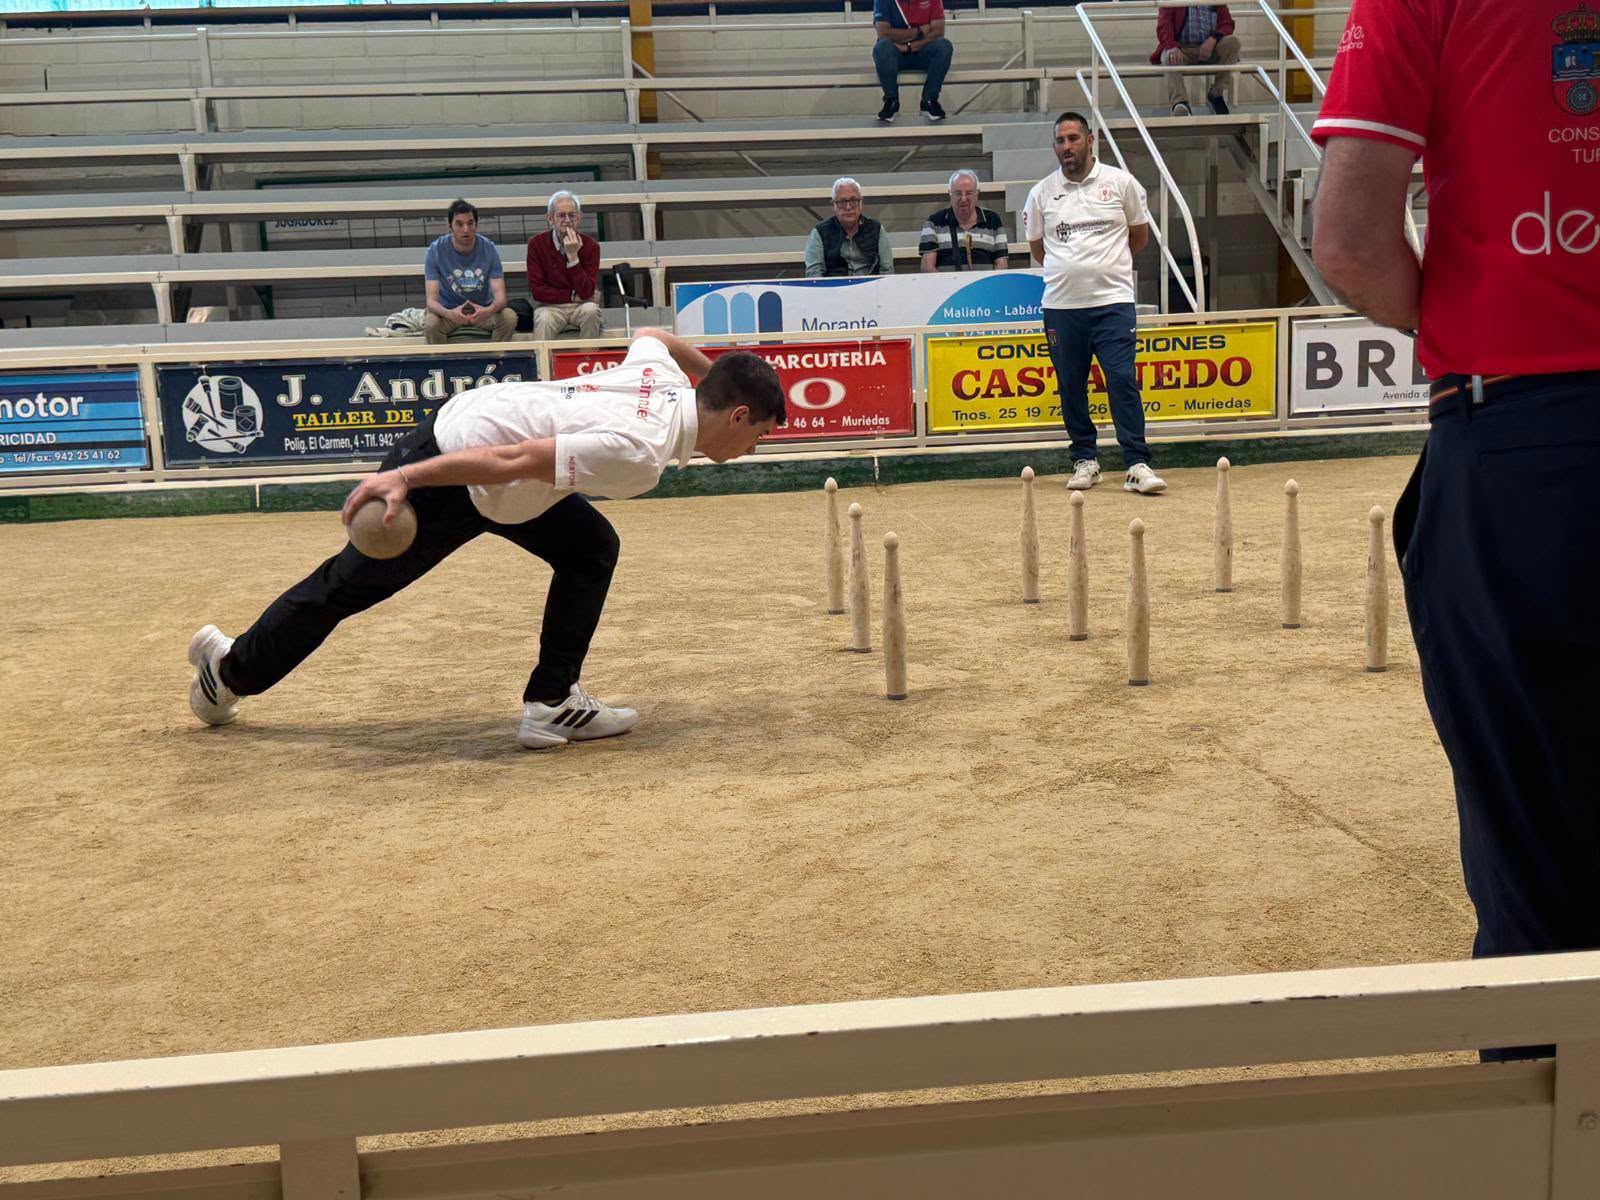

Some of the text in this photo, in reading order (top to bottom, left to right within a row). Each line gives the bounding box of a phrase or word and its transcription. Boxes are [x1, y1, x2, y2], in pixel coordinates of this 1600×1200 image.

[1548, 126, 1600, 143] CONS
[943, 306, 991, 318] Maliaño
[801, 316, 878, 331] Morante
[758, 351, 887, 370] HARCUTERIA
[276, 374, 323, 406] J.
[1382, 390, 1421, 400] Avenida
[952, 410, 991, 420] Tnos.
[999, 408, 1018, 419] 25
[1026, 406, 1041, 418] 19
[1089, 404, 1108, 415] 26
[1142, 401, 1161, 413] 70
[1184, 397, 1252, 411] Muriedas
[293, 410, 376, 427] TALLER
[385, 409, 414, 424] DE
[793, 417, 807, 428] 46
[811, 417, 825, 428] 64
[842, 414, 890, 427] Muriedas
[309, 436, 318, 450] El
[319, 434, 354, 450] Carmen,
[354, 434, 360, 448] 4
[378, 432, 394, 447] 942
[13, 451, 52, 464] Tel/Fax:
[54, 452, 74, 461] 942
[77, 450, 89, 460] 25
[92, 450, 104, 460] 41
[107, 449, 120, 459] 62
